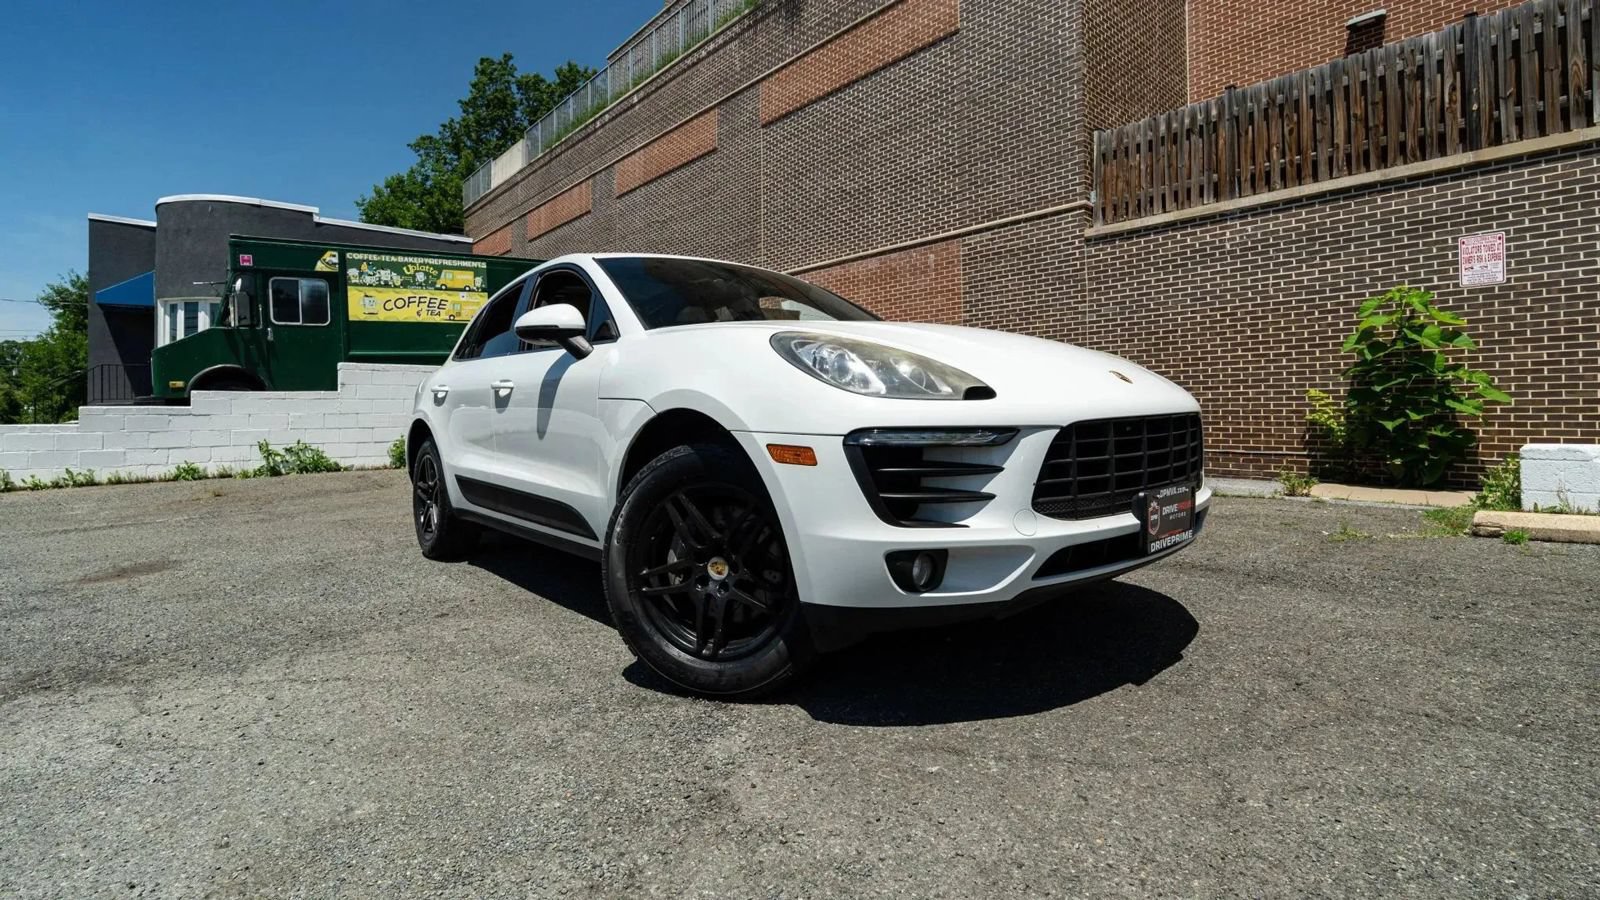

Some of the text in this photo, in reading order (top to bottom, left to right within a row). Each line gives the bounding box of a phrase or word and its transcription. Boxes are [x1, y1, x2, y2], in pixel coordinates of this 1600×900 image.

[346, 252, 487, 269] COFFEE TEA BAKERY REFRESHMENTS
[402, 262, 439, 276] Uplatte
[383, 296, 448, 312] COFFEE
[416, 308, 441, 318] & TEA
[1150, 530, 1193, 552] DRIVEPRIME
